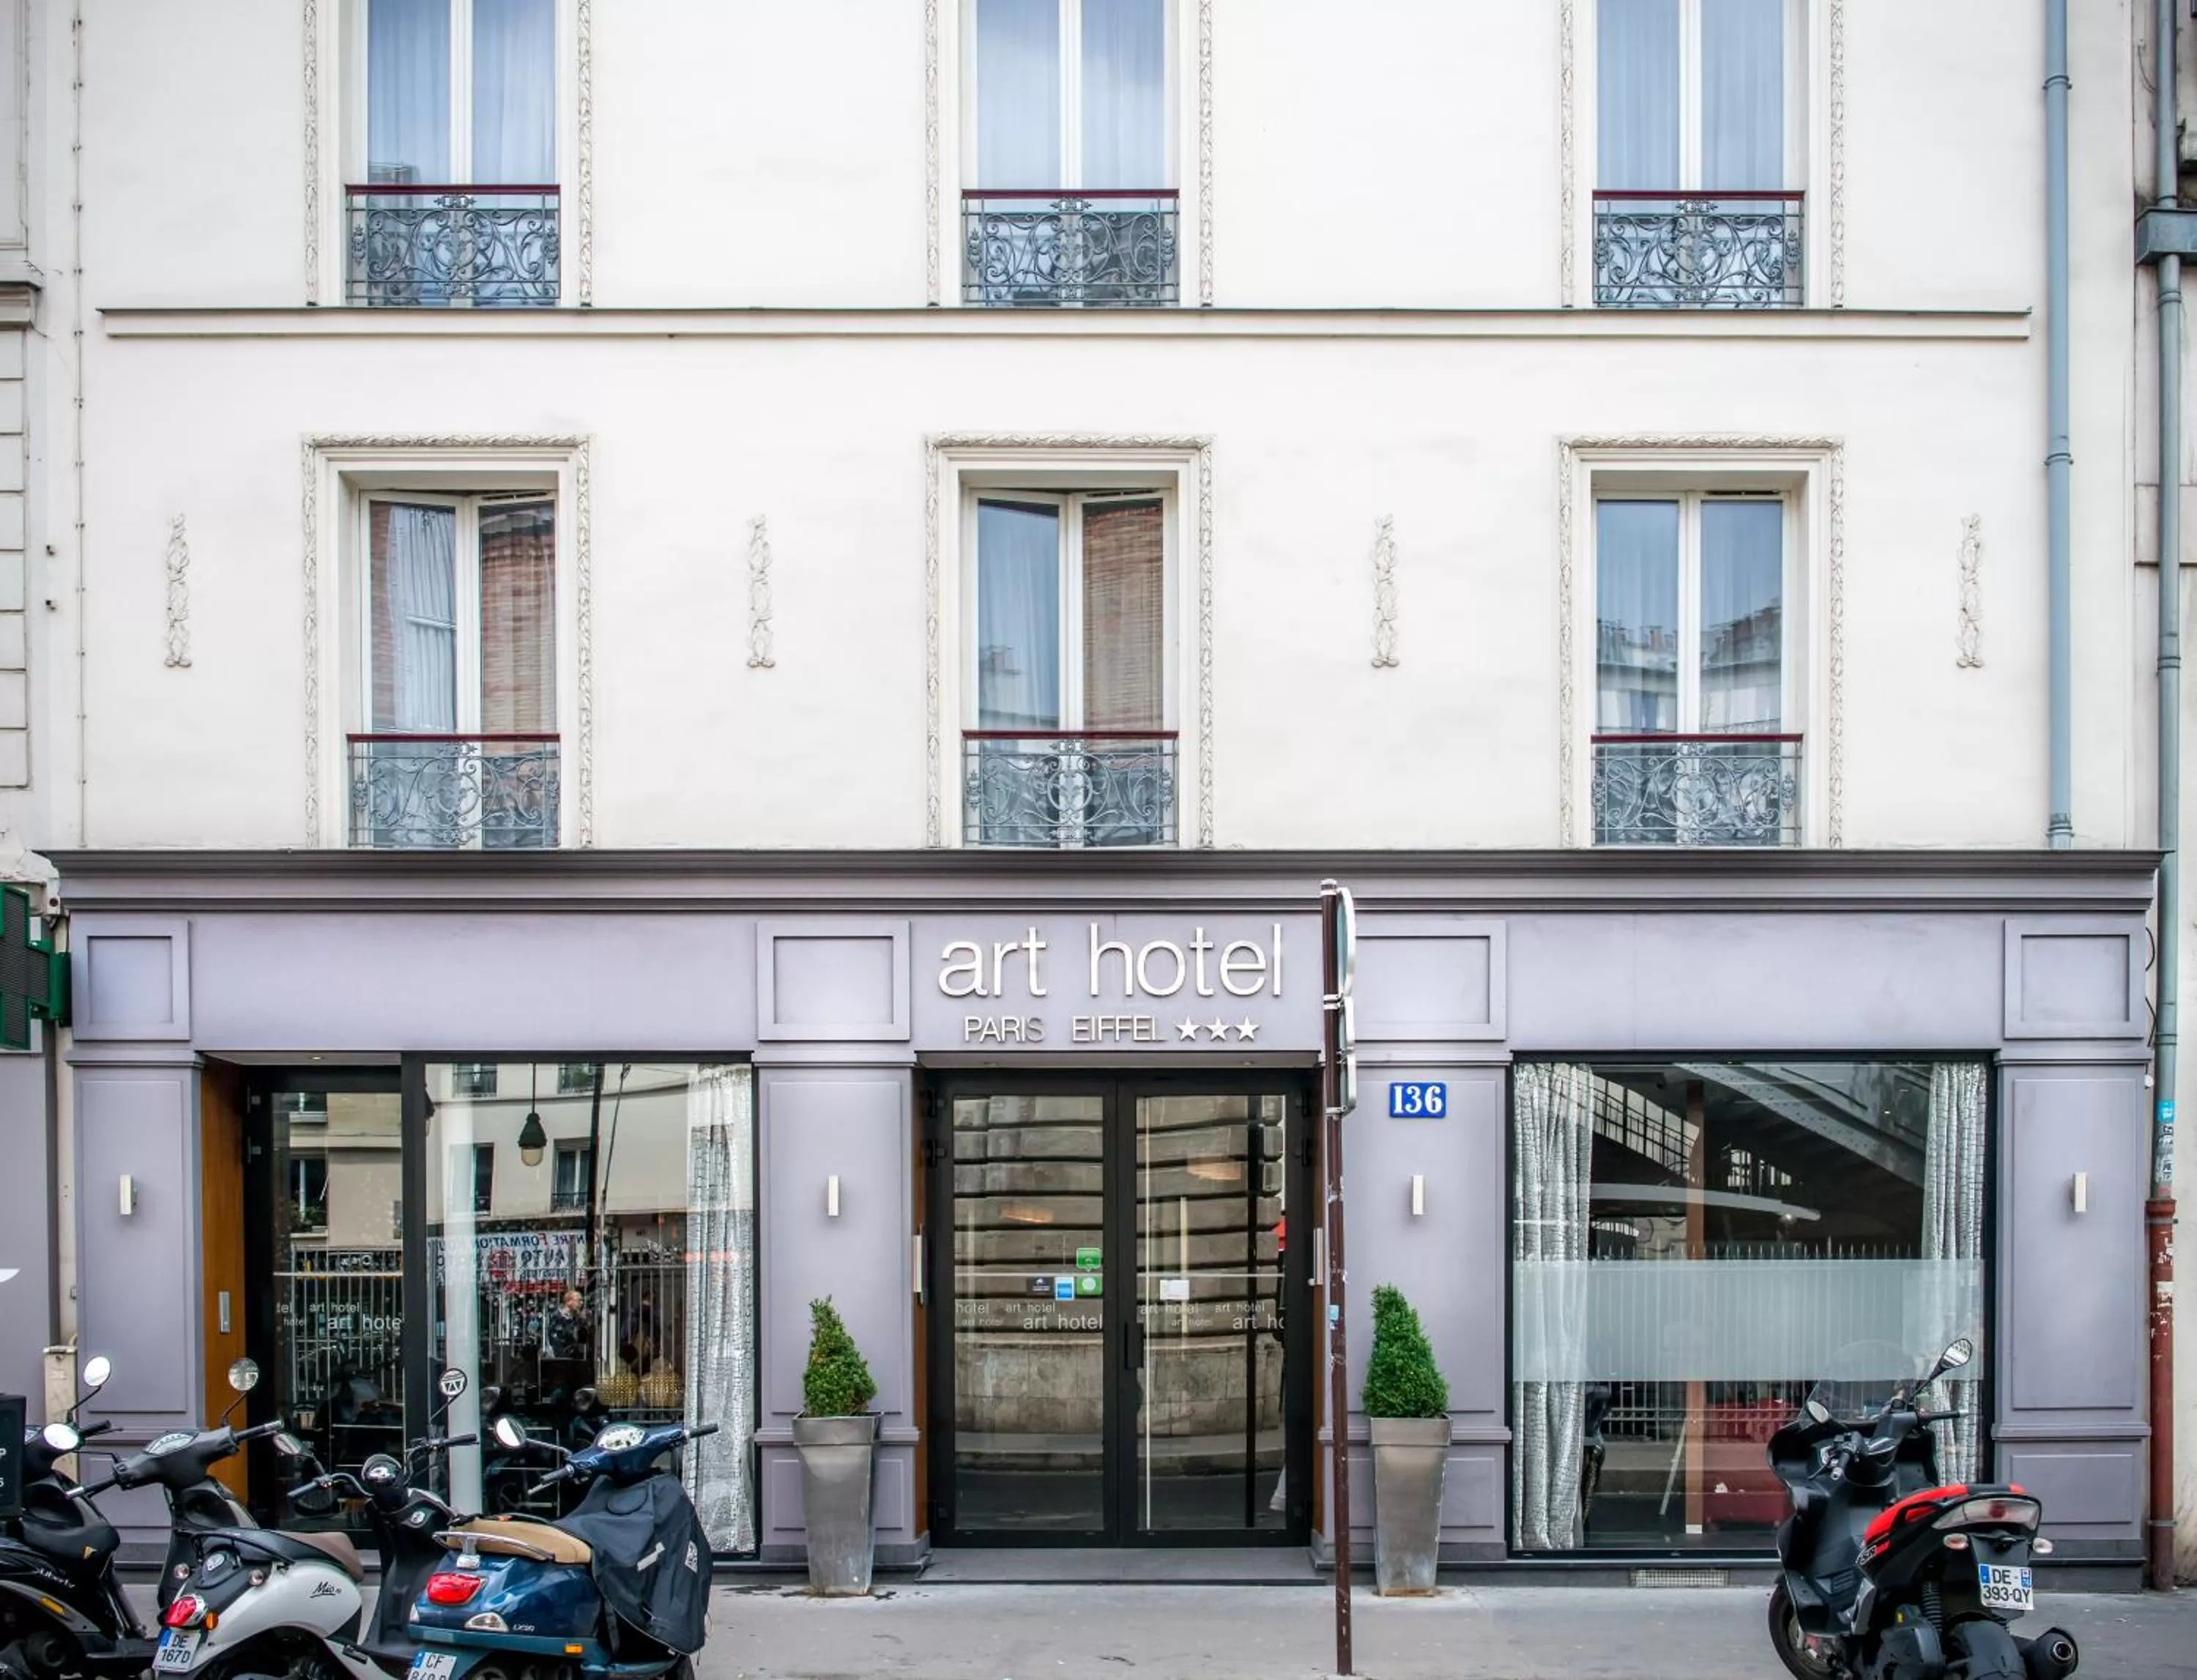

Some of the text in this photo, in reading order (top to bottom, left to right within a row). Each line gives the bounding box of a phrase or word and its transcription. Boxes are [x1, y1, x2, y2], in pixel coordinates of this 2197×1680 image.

[938, 922, 1282, 997] art hotel
[963, 1016, 1166, 1042] PARIS EIFFEL
[1393, 1085, 1443, 1114] 136
[309, 1301, 360, 1313] art hotel
[955, 1302, 989, 1314] hotel
[1005, 1302, 1055, 1313] art hotel
[1215, 1302, 1231, 1313] art
[327, 1315, 352, 1329] art
[1023, 1314, 1103, 1329] art hotel
[1233, 1315, 1257, 1329] art
[1983, 1585, 2030, 1602] 393-QY
[172, 1634, 190, 1648] DE
[426, 1655, 445, 1669] CF
